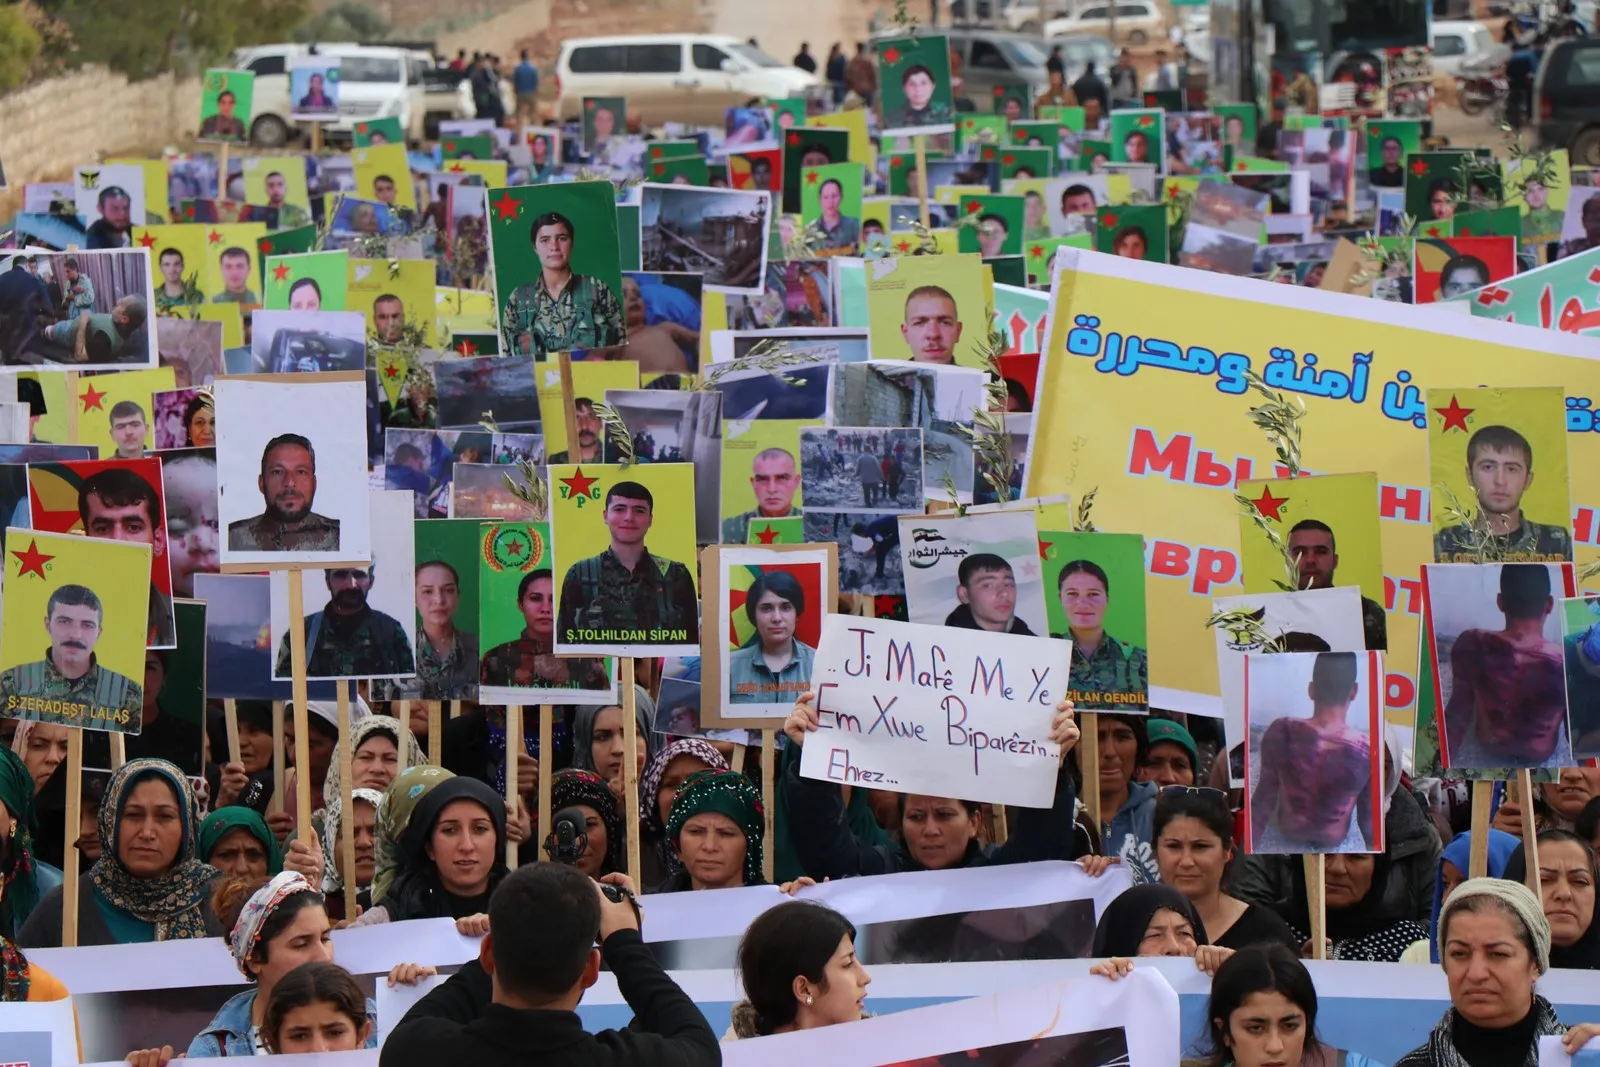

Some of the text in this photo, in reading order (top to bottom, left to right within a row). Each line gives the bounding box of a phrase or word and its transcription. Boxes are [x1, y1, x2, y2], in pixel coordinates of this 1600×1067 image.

[1066, 314, 1251, 395] ومحررة
[1263, 347, 1374, 404] آمنة
[566, 627, 687, 644] Ş.TOLHILDAN SÎPAN
[886, 638, 953, 691] Mafê
[970, 655, 1014, 701] Me
[1027, 667, 1051, 706] Ye
[90, 706, 130, 724] LALAŞ
[816, 683, 862, 733] Em
[868, 694, 928, 742] Xwe
